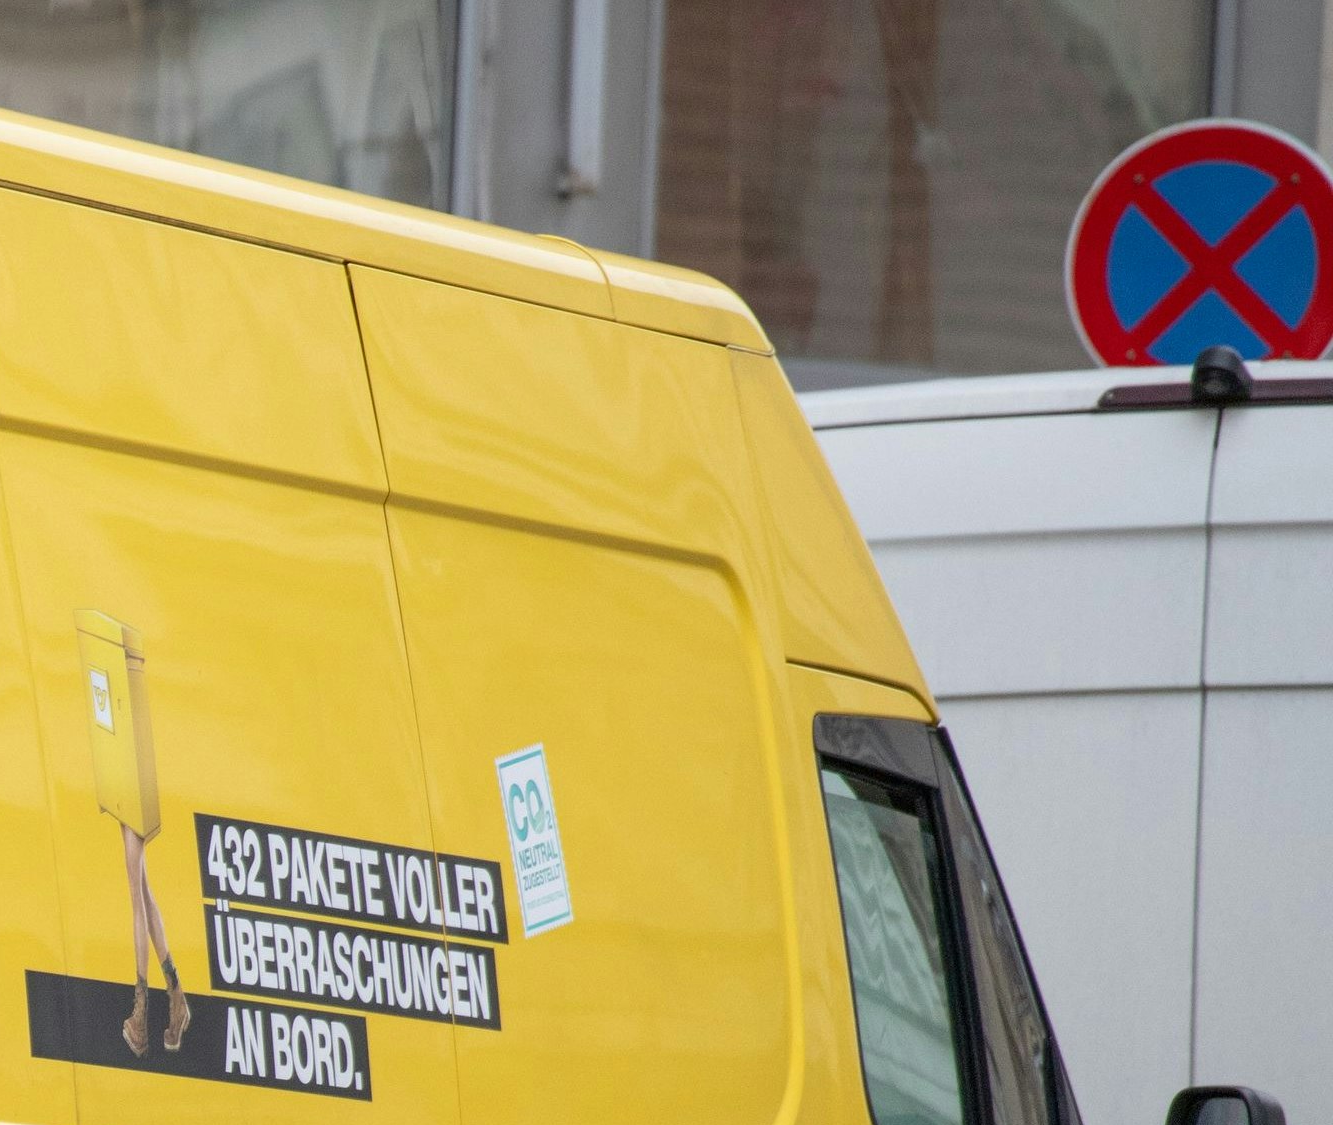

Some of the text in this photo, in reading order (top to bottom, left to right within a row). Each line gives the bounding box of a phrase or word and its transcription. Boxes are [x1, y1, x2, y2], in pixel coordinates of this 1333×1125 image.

[207, 824, 499, 935] 432 PAKETE VOLLER
[518, 839, 559, 871] NEUTRAL
[522, 863, 562, 892] ZUGESTELLT
[213, 899, 491, 1020] ÜBERRASCHUNGEN
[225, 1006, 363, 1091] AN BORD.
